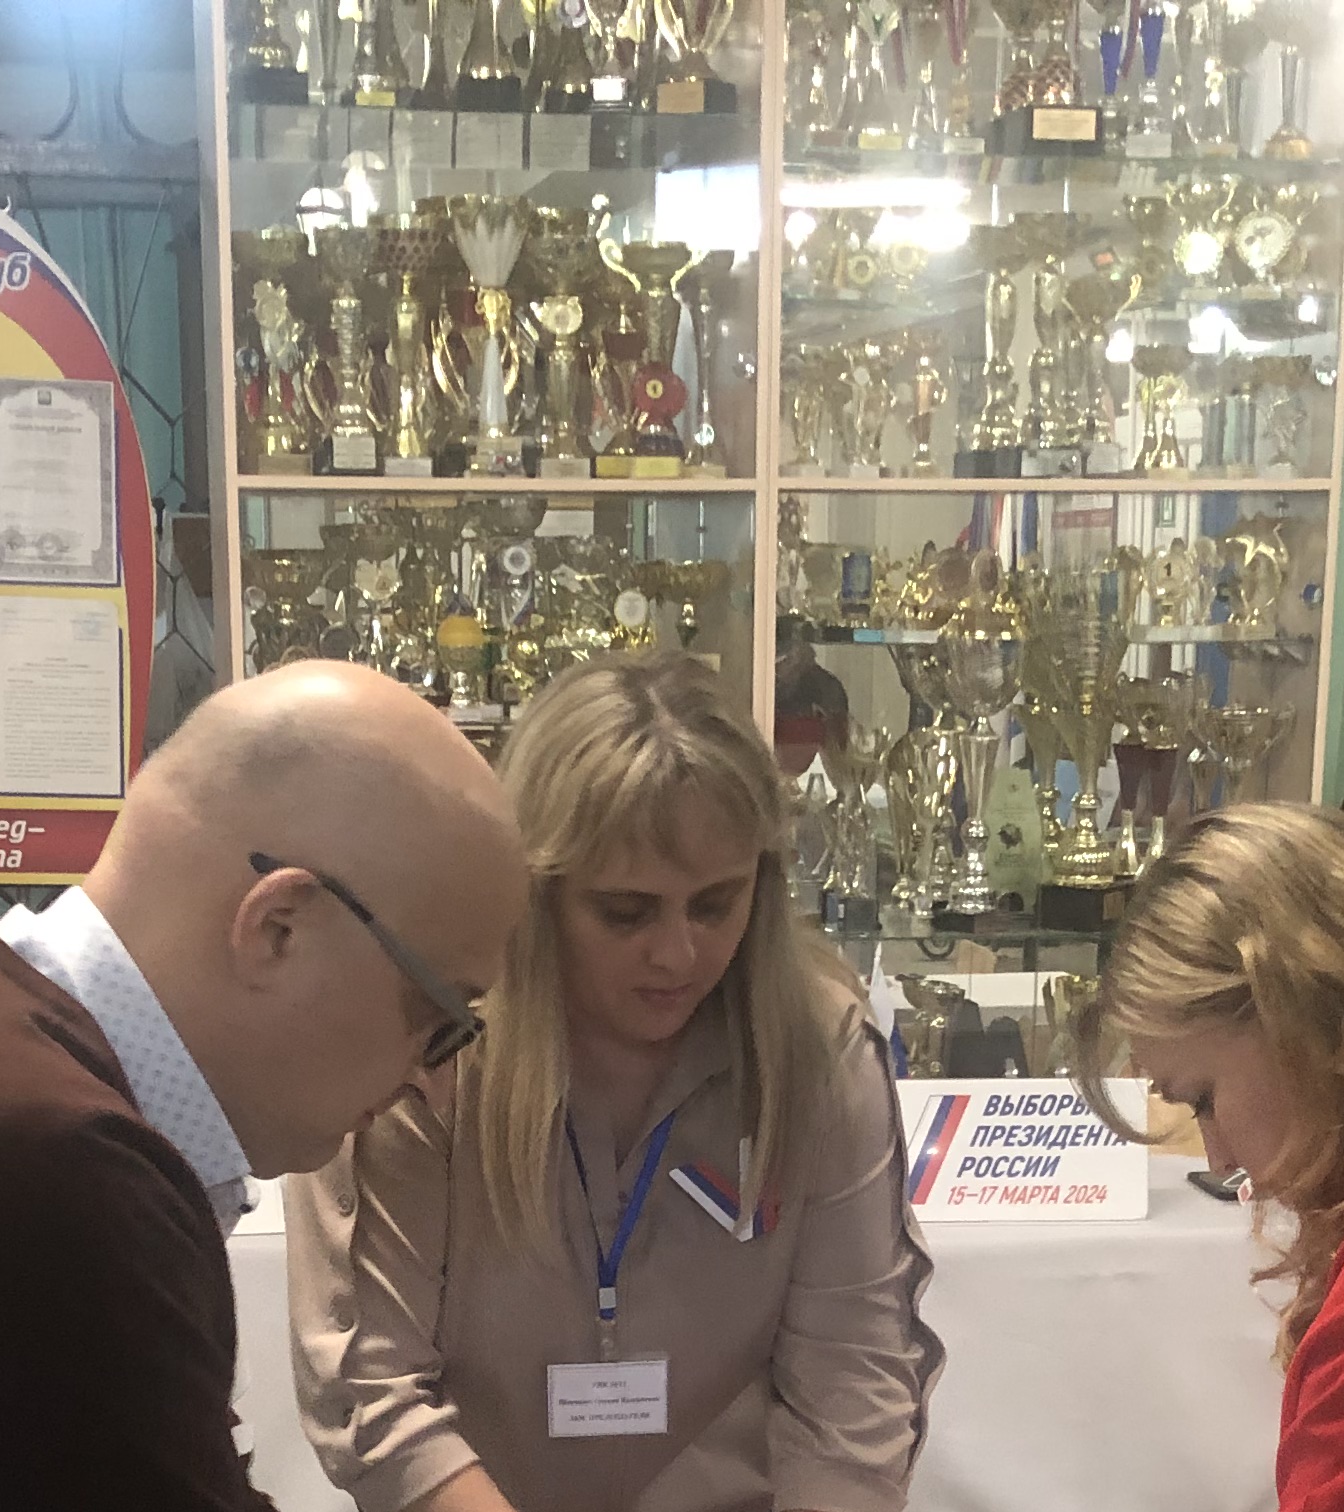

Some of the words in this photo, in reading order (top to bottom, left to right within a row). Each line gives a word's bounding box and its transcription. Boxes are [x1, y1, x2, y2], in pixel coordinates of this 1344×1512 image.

[956, 1155, 1061, 1179] РОССИИ
[997, 1185, 1061, 1205] МАРТА
[1062, 1184, 1109, 1205] 2024
